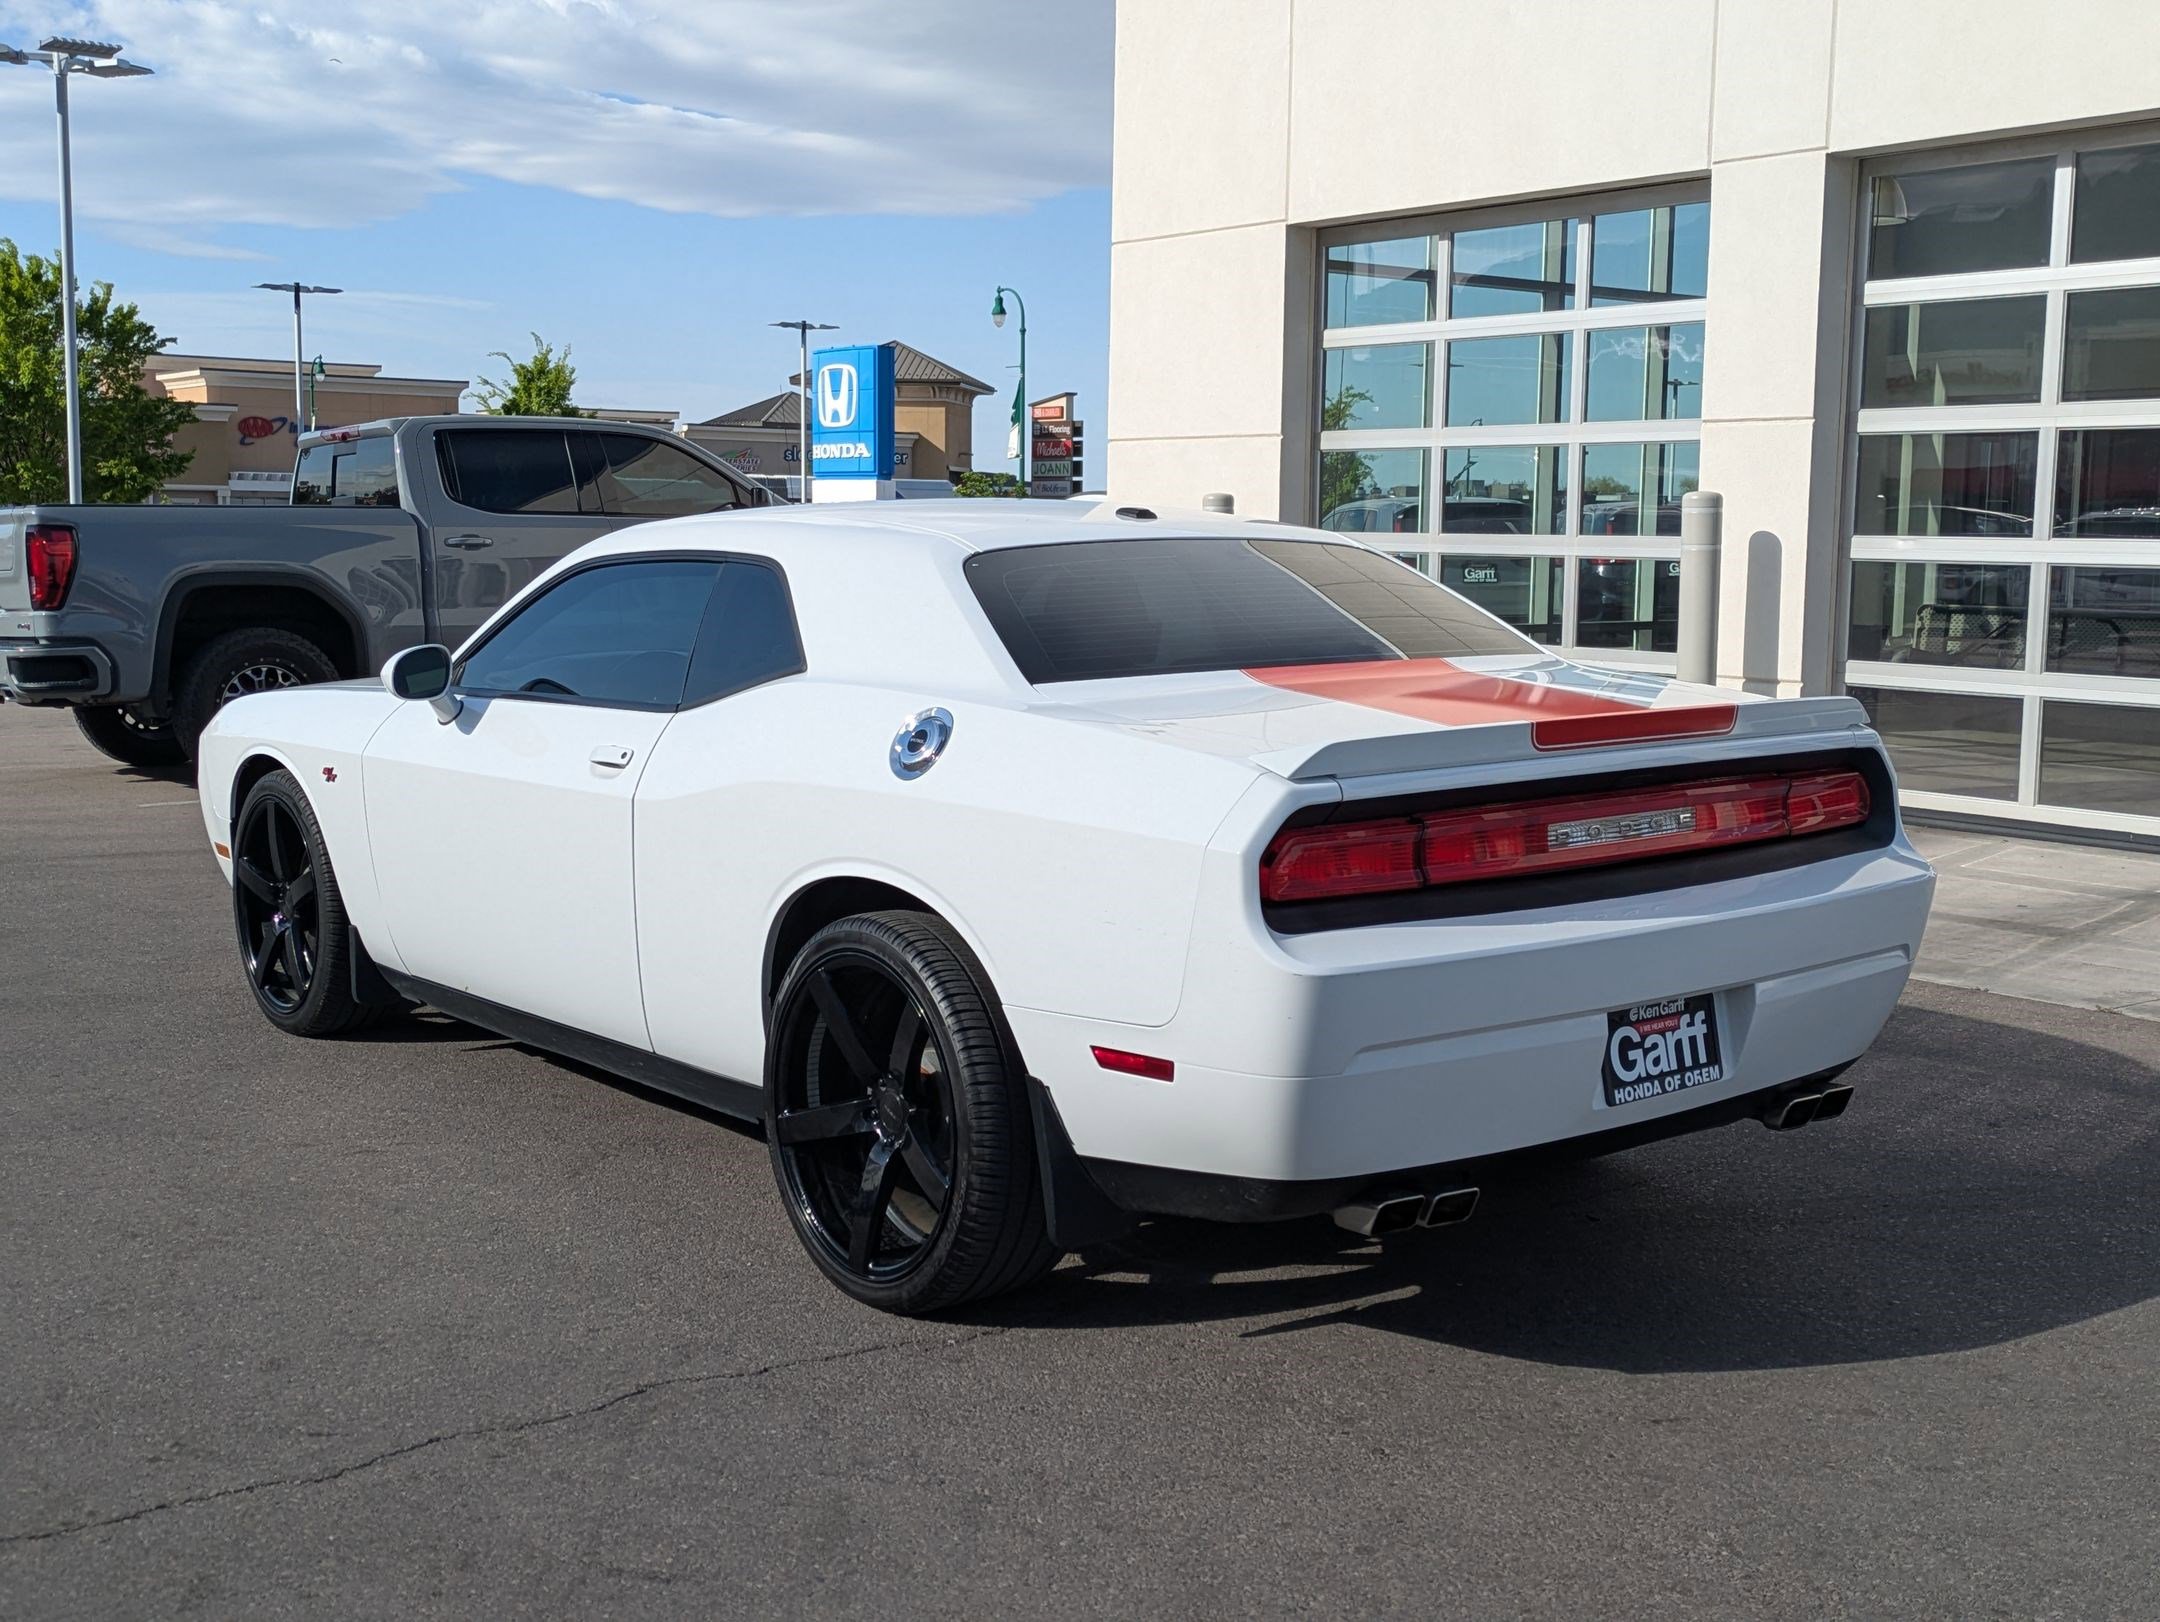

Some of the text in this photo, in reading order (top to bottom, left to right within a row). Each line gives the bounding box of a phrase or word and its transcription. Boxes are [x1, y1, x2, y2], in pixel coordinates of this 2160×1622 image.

[812, 442, 871, 459] HONDA
[1037, 441, 1067, 457] Michaels
[1034, 463, 1070, 475] JOANN
[1464, 567, 1496, 579] Garff
[1610, 1010, 1708, 1083] Garff
[1614, 1065, 1720, 1105] HONDA OF OREM
